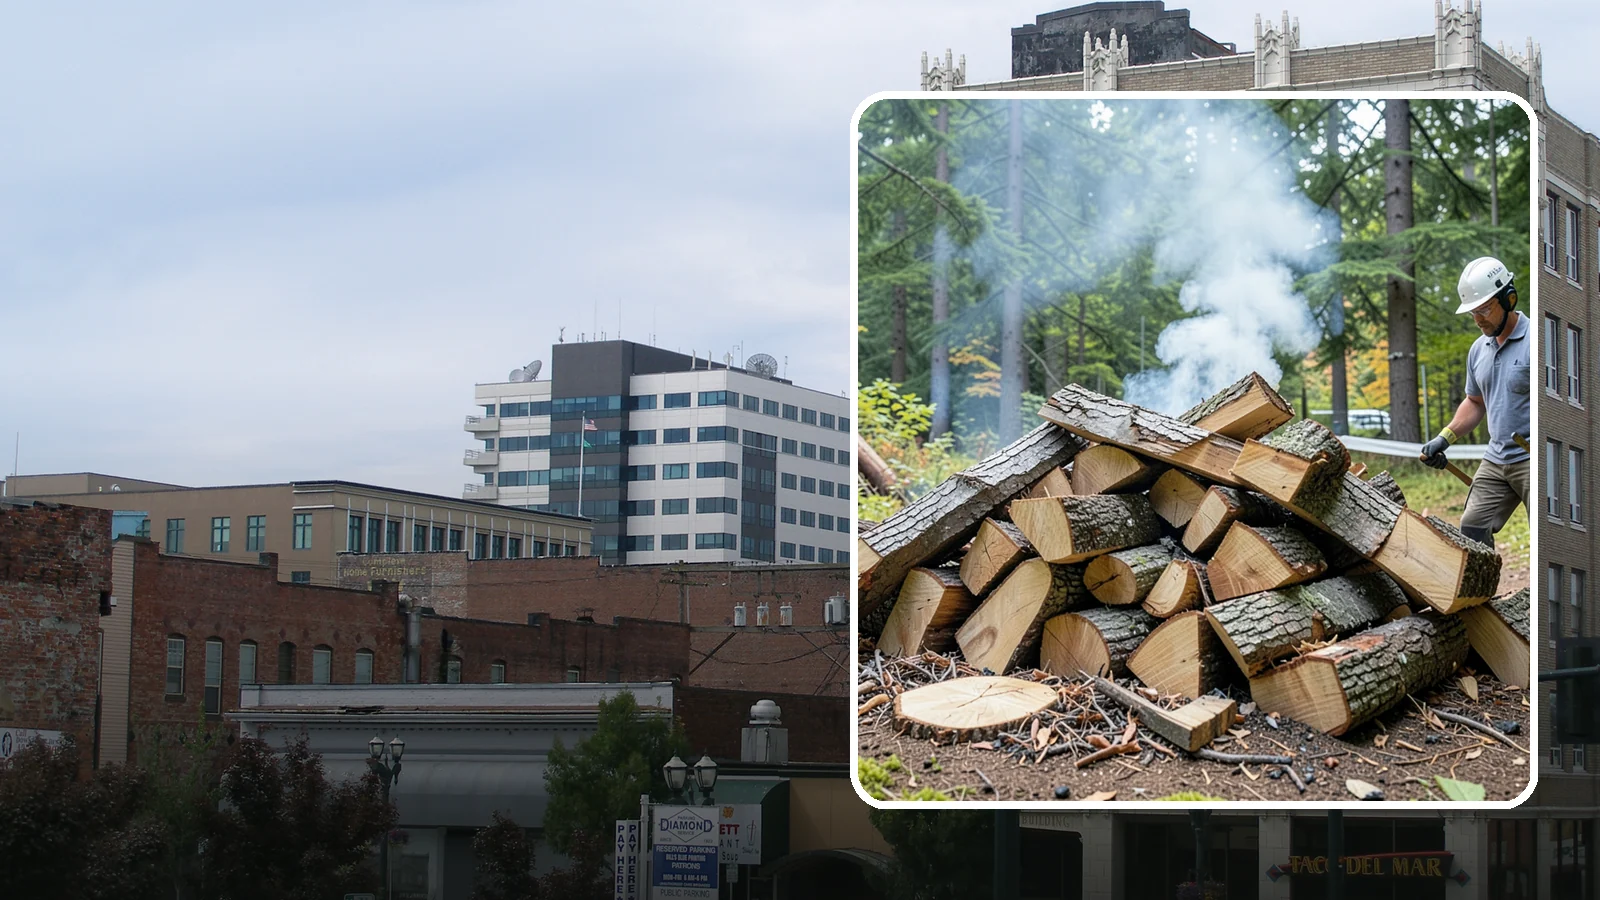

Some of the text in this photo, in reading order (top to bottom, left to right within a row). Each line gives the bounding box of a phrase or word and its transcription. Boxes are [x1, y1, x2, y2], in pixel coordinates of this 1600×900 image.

[343, 565, 427, 577] Home Furnishers
[660, 818, 713, 833] DIAMOND
[1022, 815, 1070, 827] BUILDING
[656, 845, 716, 854] RESERVED PARKING
[617, 825, 625, 893] PAY HERE
[627, 824, 637, 893] PAY HERE
[671, 862, 701, 870] PATRONS
[1346, 856, 1385, 875] DEL
[1392, 857, 1442, 877] MAR
[660, 888, 710, 898] PUBLIC PARKING
